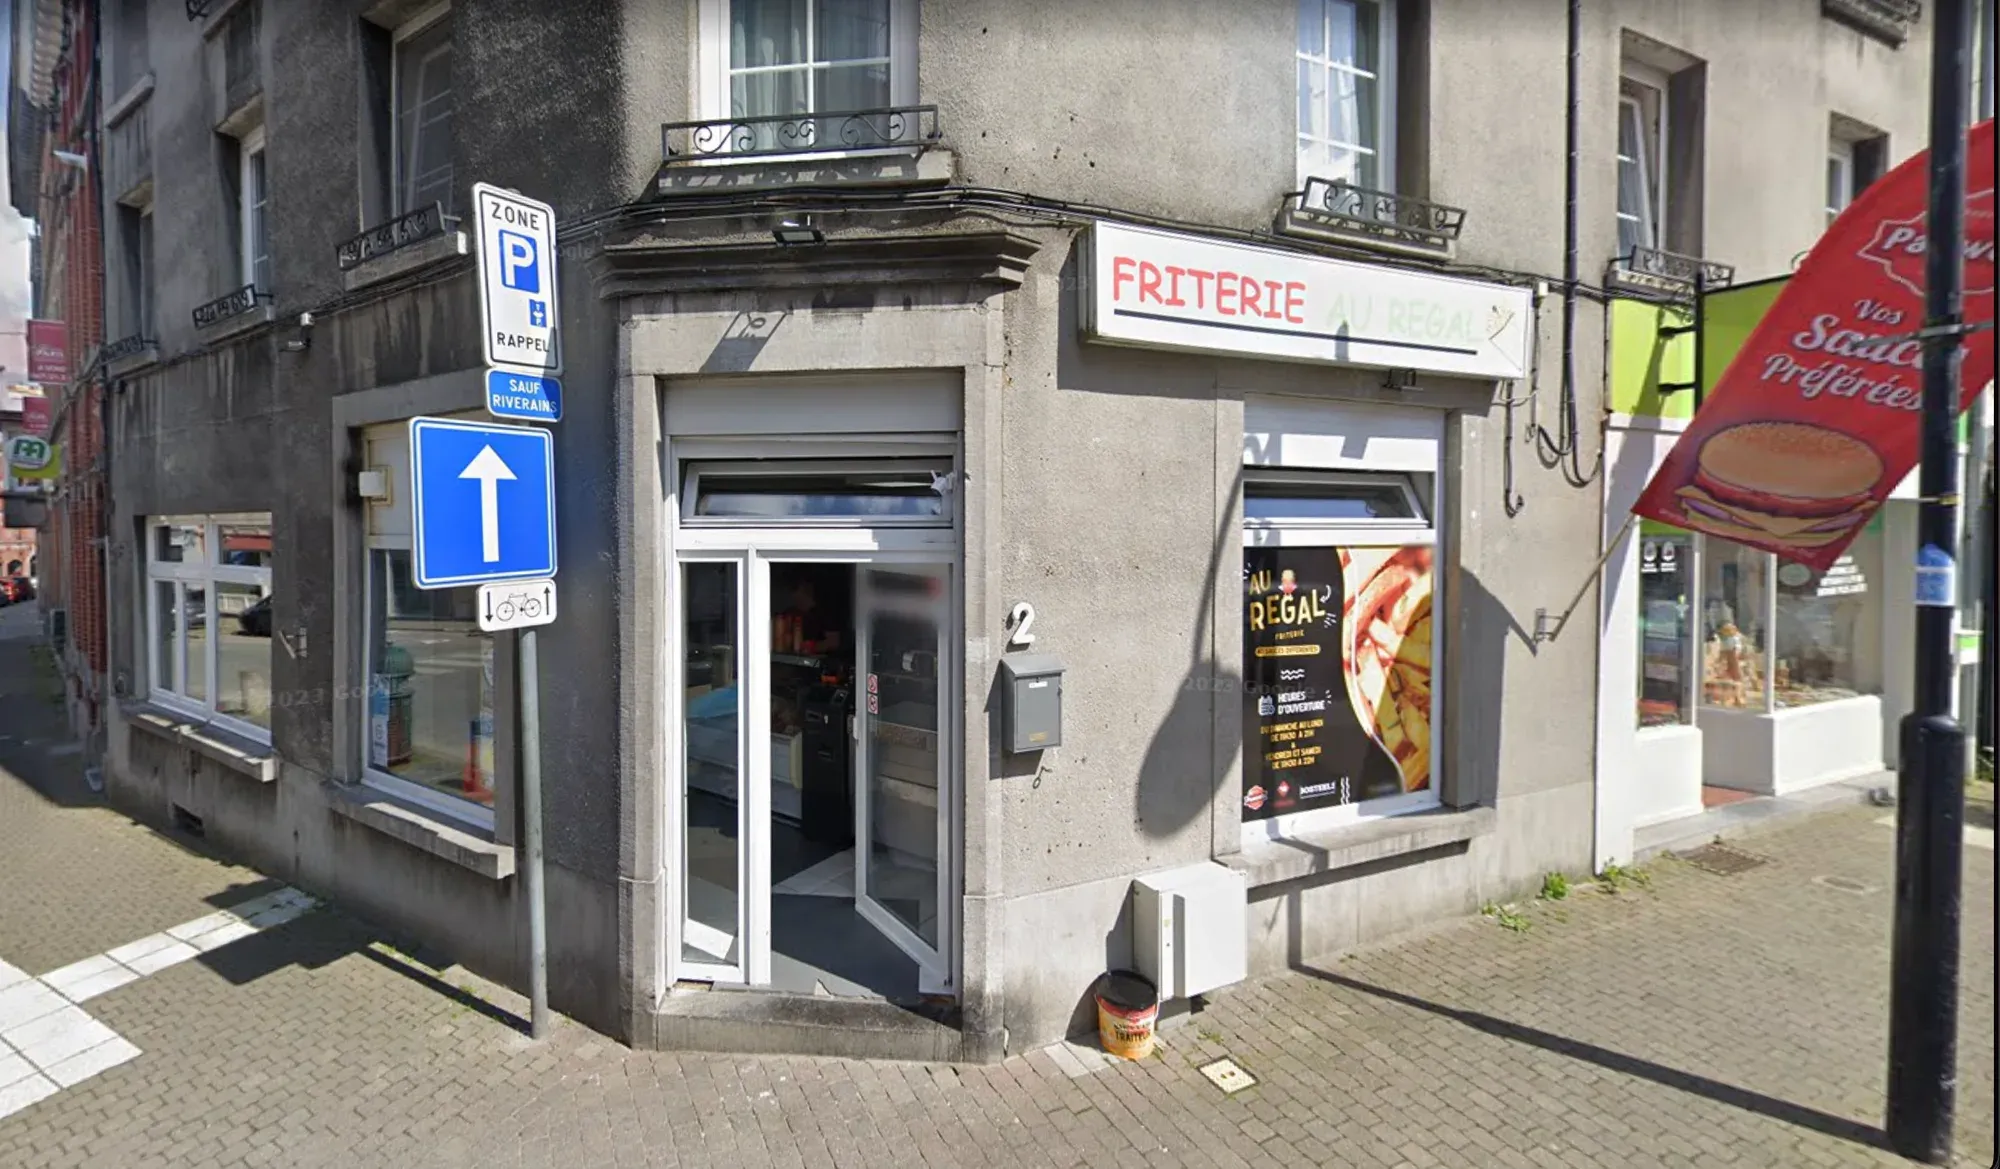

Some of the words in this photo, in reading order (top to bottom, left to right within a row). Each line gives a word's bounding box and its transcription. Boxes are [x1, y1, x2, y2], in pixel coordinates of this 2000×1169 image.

[490, 201, 540, 231] ZONE
[502, 232, 535, 287] P
[1112, 256, 1307, 324] FRITERIE
[1325, 293, 1373, 334] AU
[1387, 299, 1486, 342] REGAL
[1854, 298, 1904, 325] Vos
[496, 331, 550, 353] RAPPEL
[509, 378, 541, 394] SAUF
[492, 393, 557, 414] RIVERAINS
[1249, 569, 1271, 595] AU
[1012, 601, 1035, 645] 2
[1250, 589, 1326, 631] REGAL
[1278, 691, 1306, 703] HEURES
[1278, 700, 1326, 715] D'OUVERTURE
